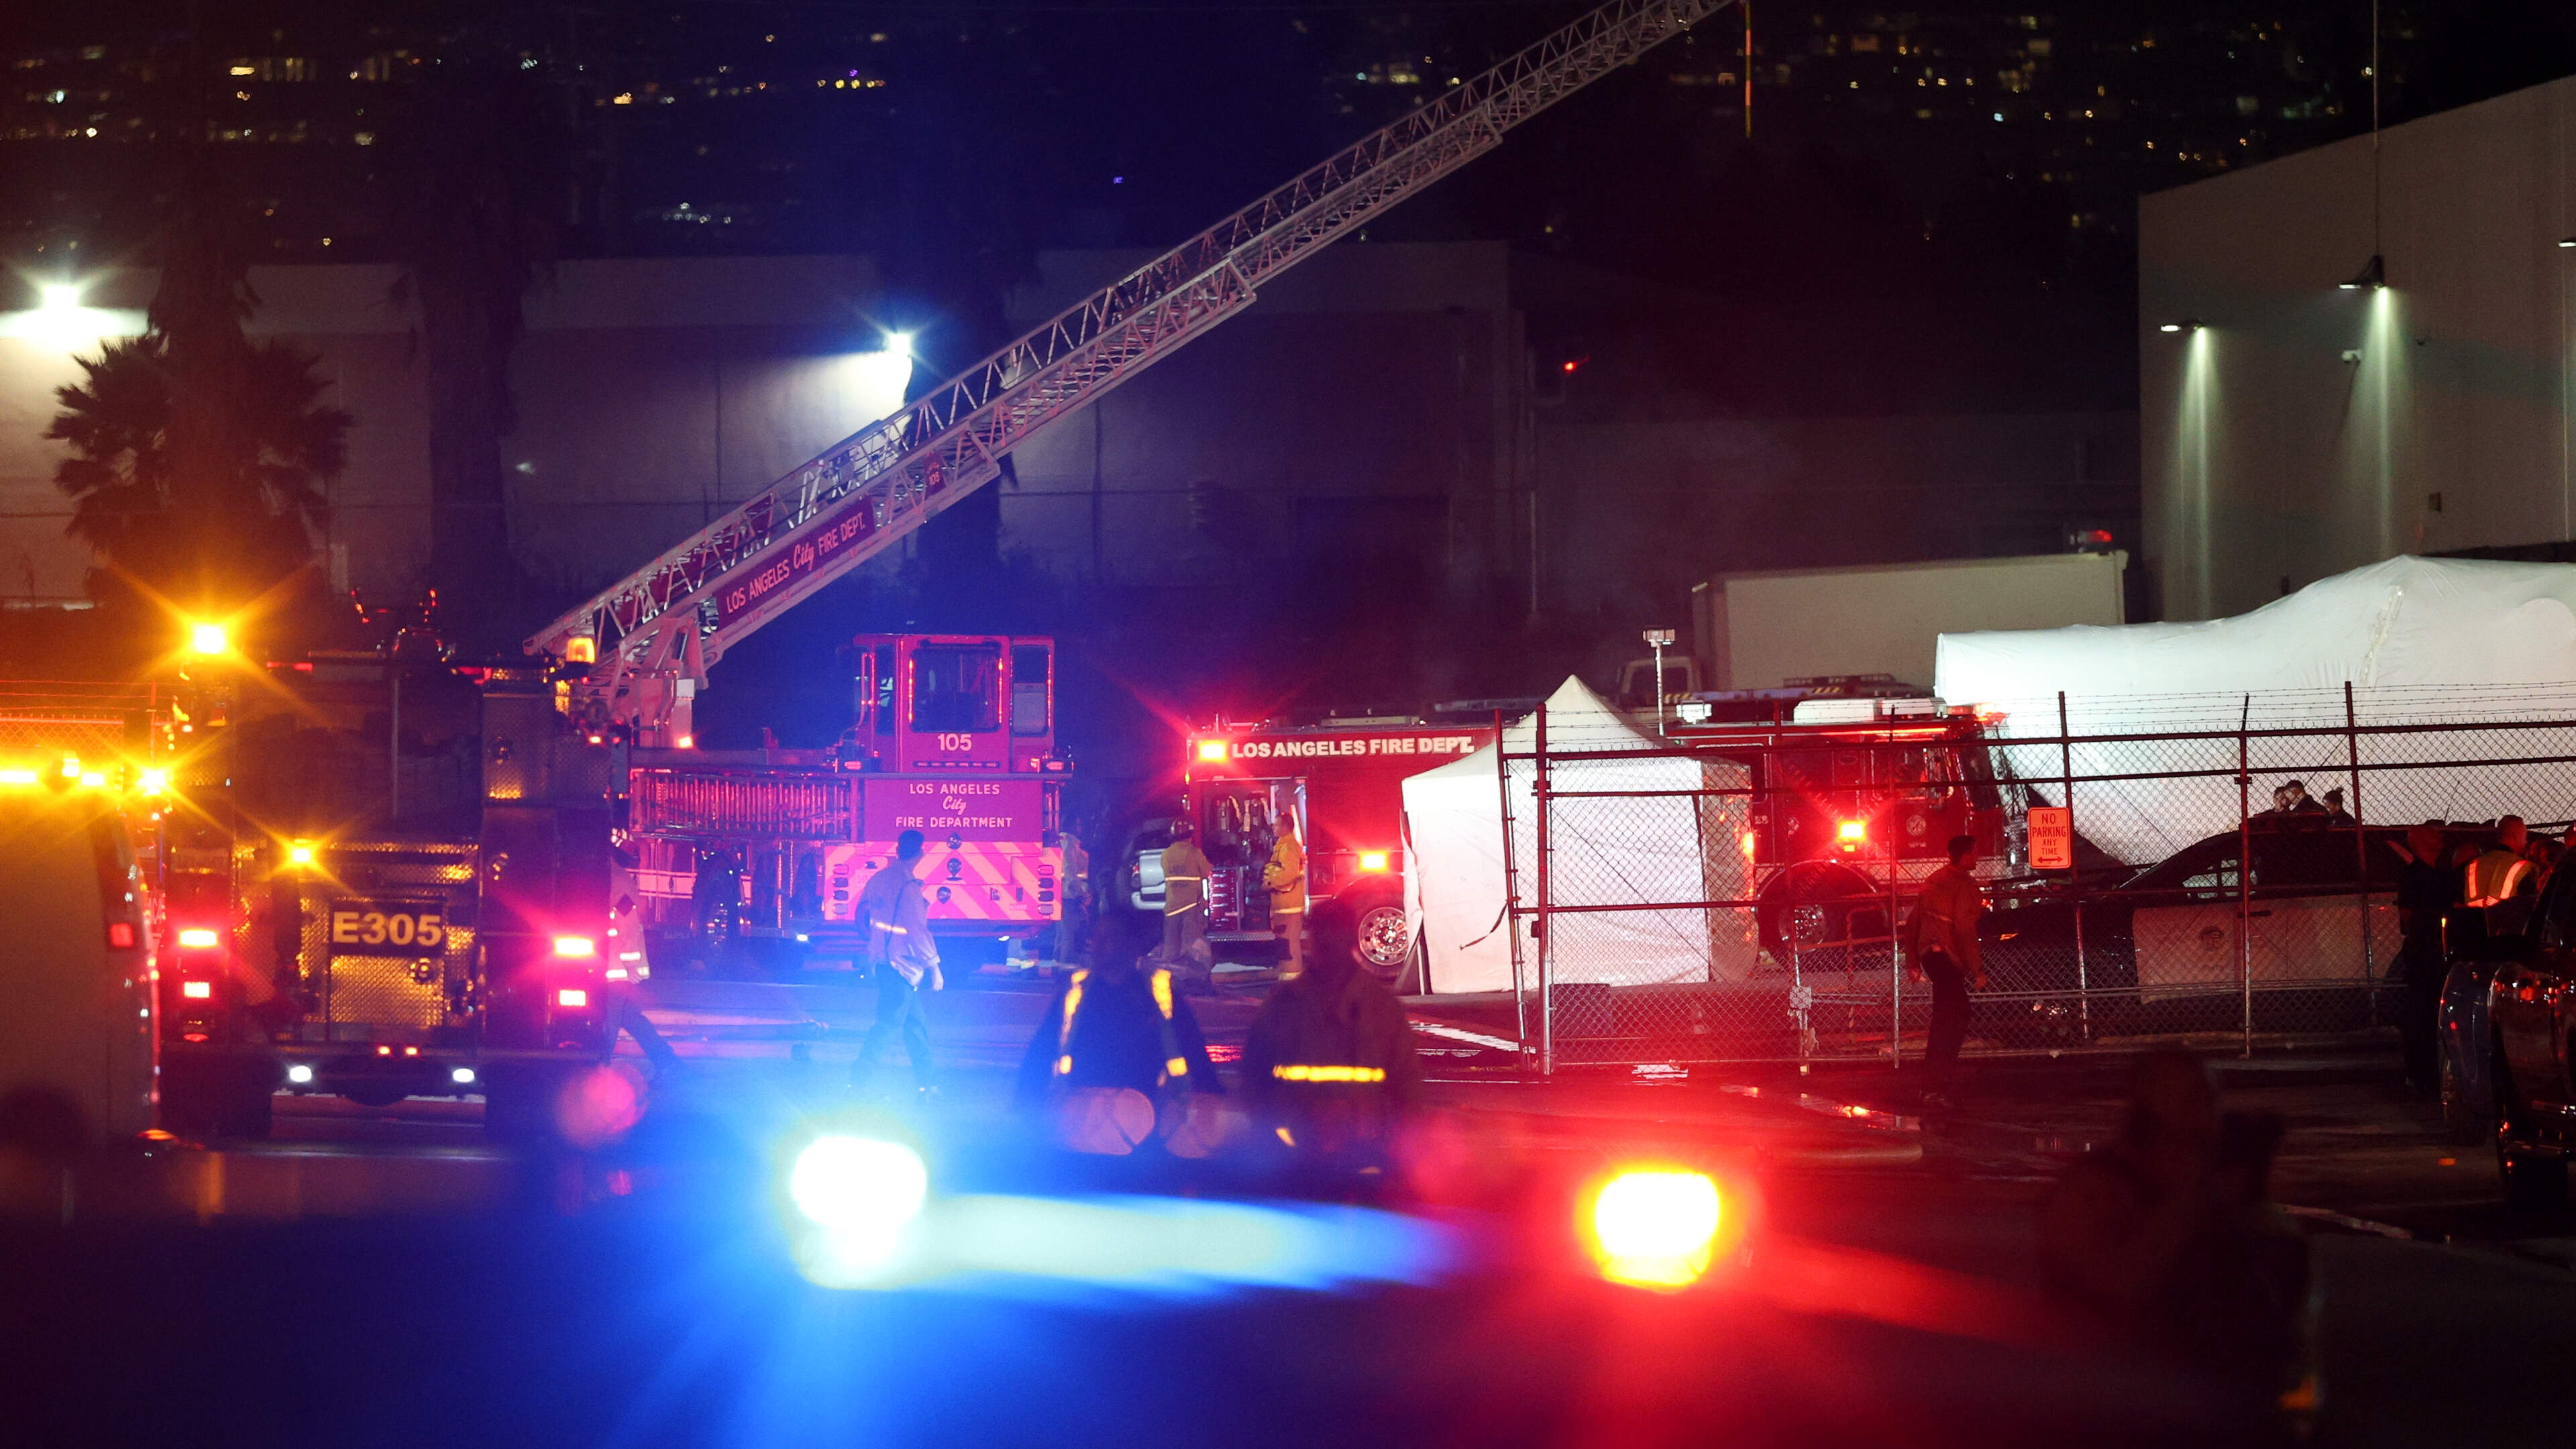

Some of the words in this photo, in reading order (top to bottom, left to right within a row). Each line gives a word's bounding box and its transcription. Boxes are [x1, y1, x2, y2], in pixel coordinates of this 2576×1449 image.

[727, 587, 746, 614] LOS
[749, 559, 790, 600] ANGELES
[793, 542, 815, 571] City
[818, 528, 839, 556] FIRE
[840, 512, 866, 542] DEPT.
[937, 733, 972, 751] 105
[1232, 742, 1271, 758] LOS
[1273, 740, 1368, 757] ANGELES
[1369, 737, 1415, 755] FIRE
[1418, 736, 1474, 753] DEPT.
[910, 784, 934, 795] LOS
[940, 784, 1000, 795] ANGELES
[943, 796, 967, 815] City
[896, 816, 924, 828] FIRE
[930, 816, 1013, 828] DEPARTMENT
[2041, 813, 2056, 824] NO
[2032, 826, 2067, 838] PARKING
[2042, 839, 2057, 847] ANY
[2041, 847, 2058, 855] TIME
[333, 912, 443, 947] E305
